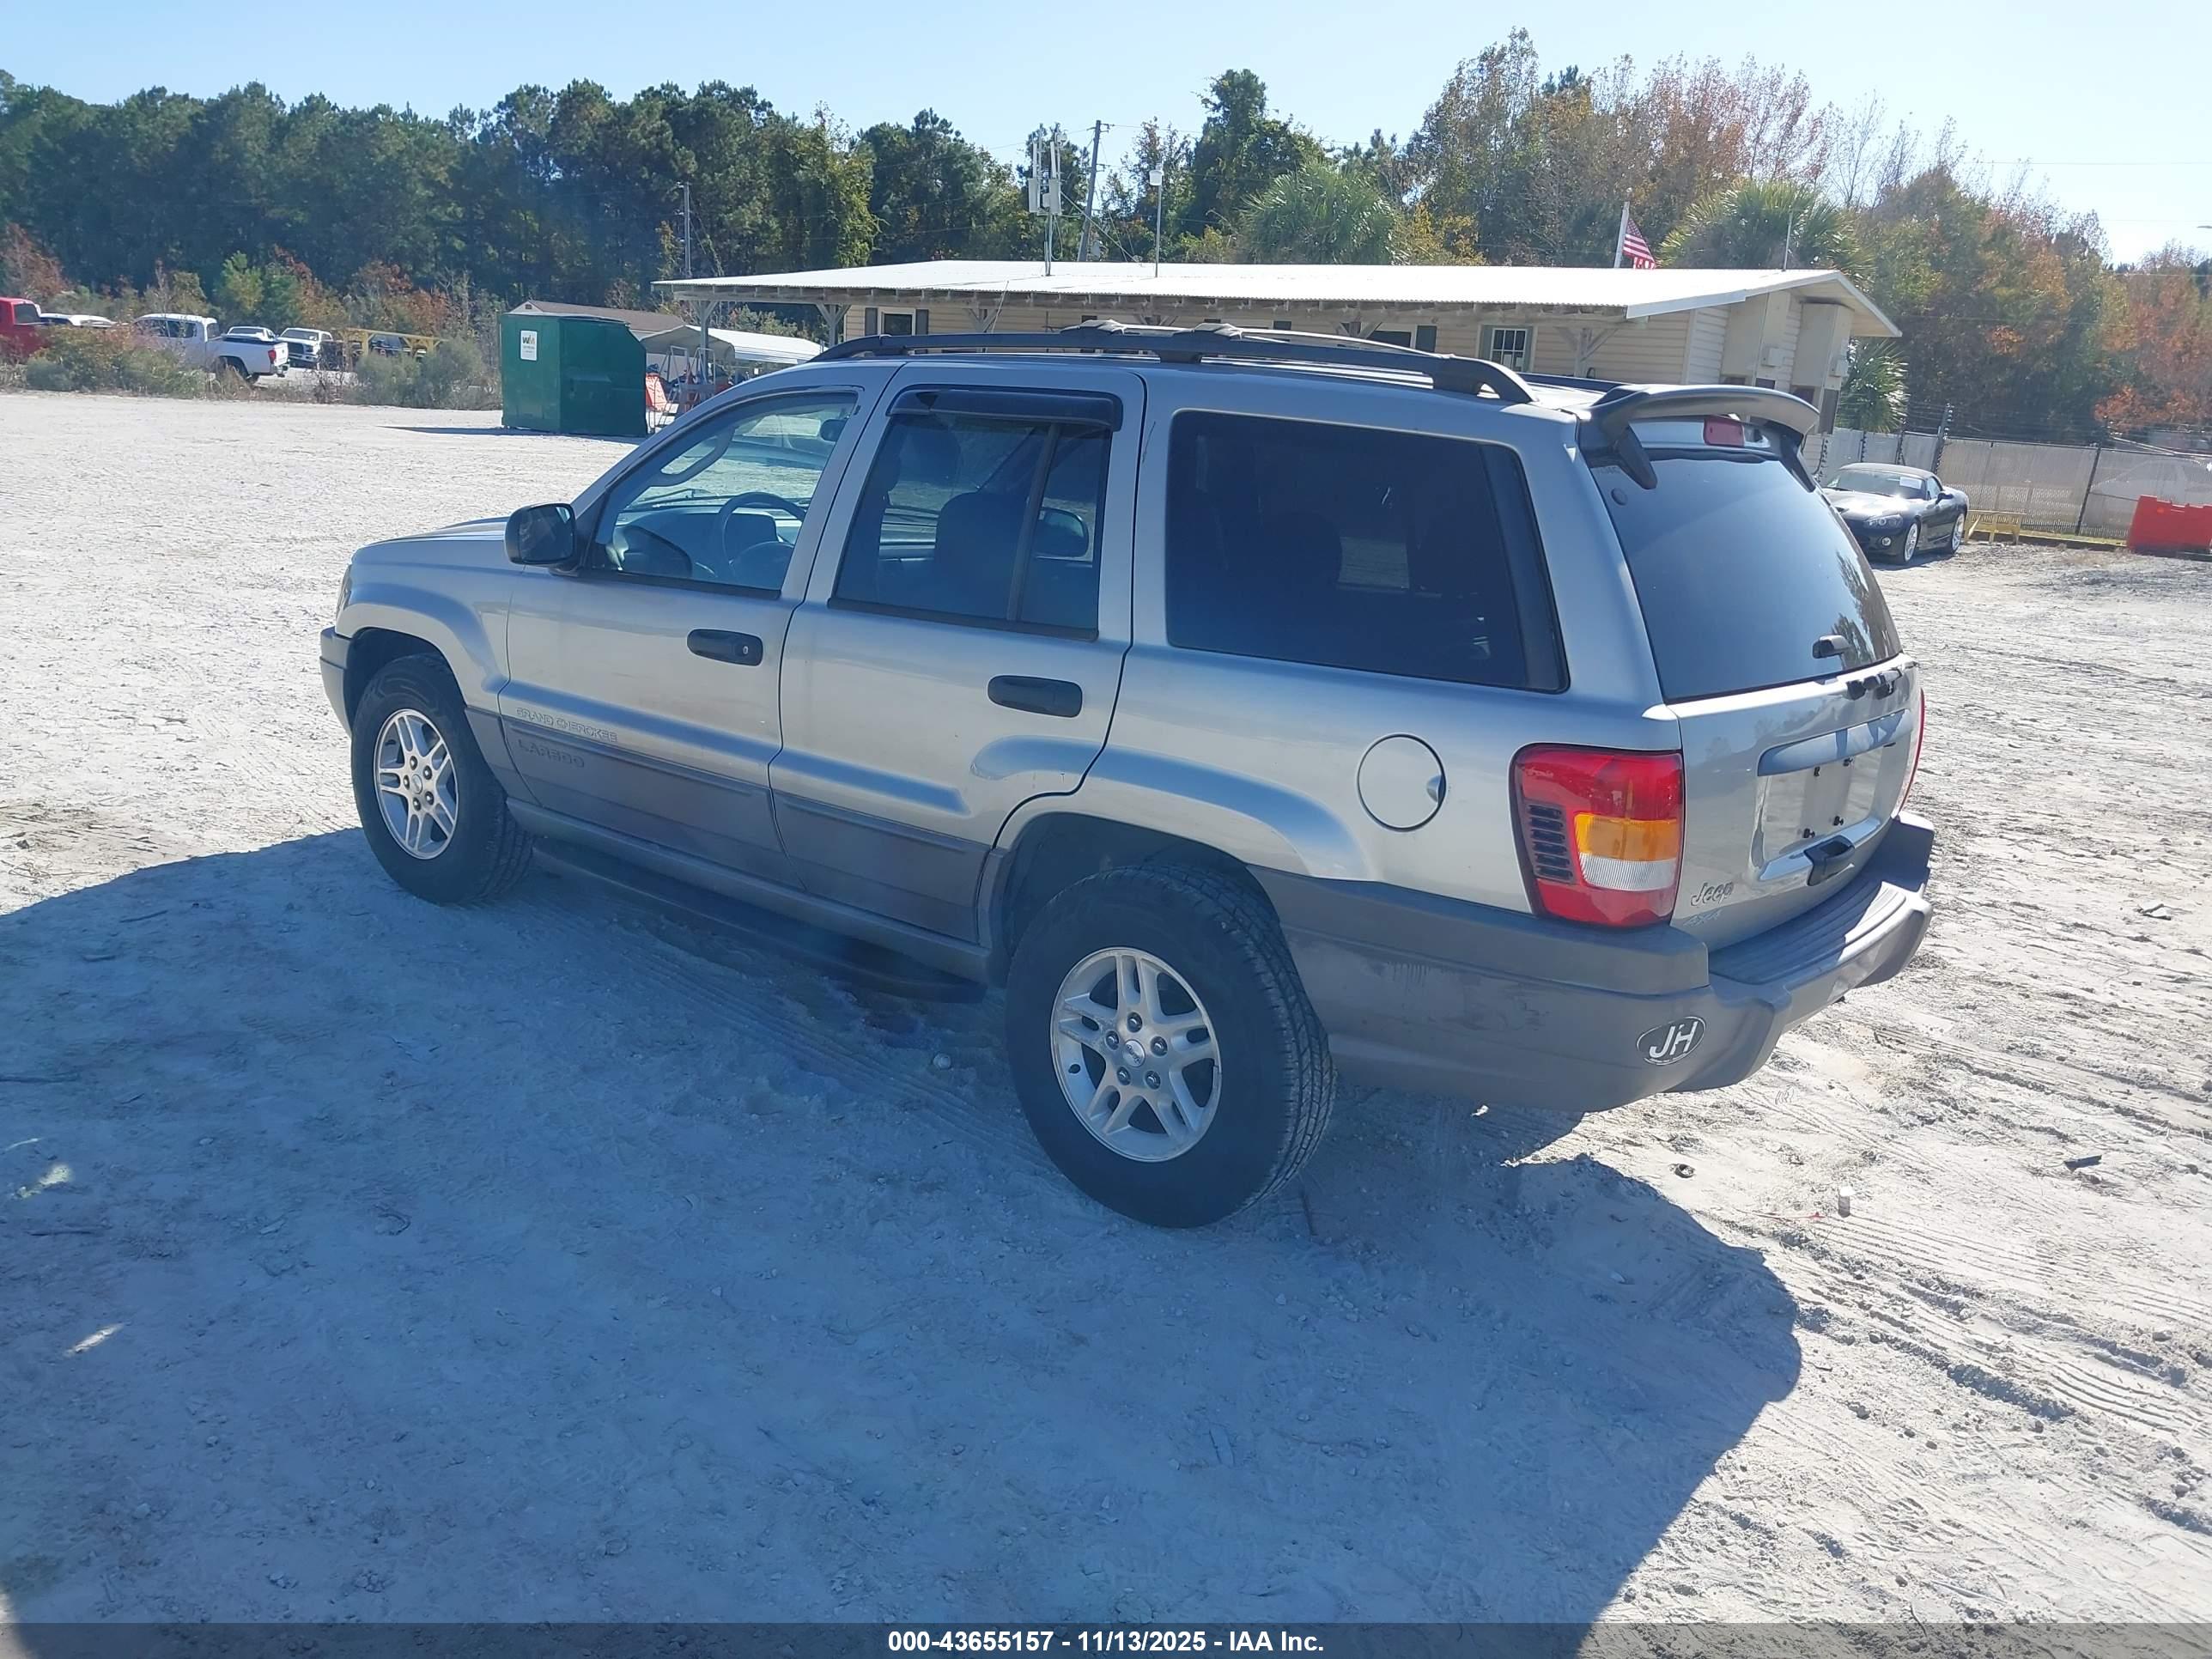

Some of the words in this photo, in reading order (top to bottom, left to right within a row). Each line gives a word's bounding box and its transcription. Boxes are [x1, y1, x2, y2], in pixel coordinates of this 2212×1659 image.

[516, 707, 554, 726] GRAND
[556, 718, 618, 743] CHEROKEE
[1690, 881, 1734, 907] Jeep
[1649, 1020, 1699, 1059] JH
